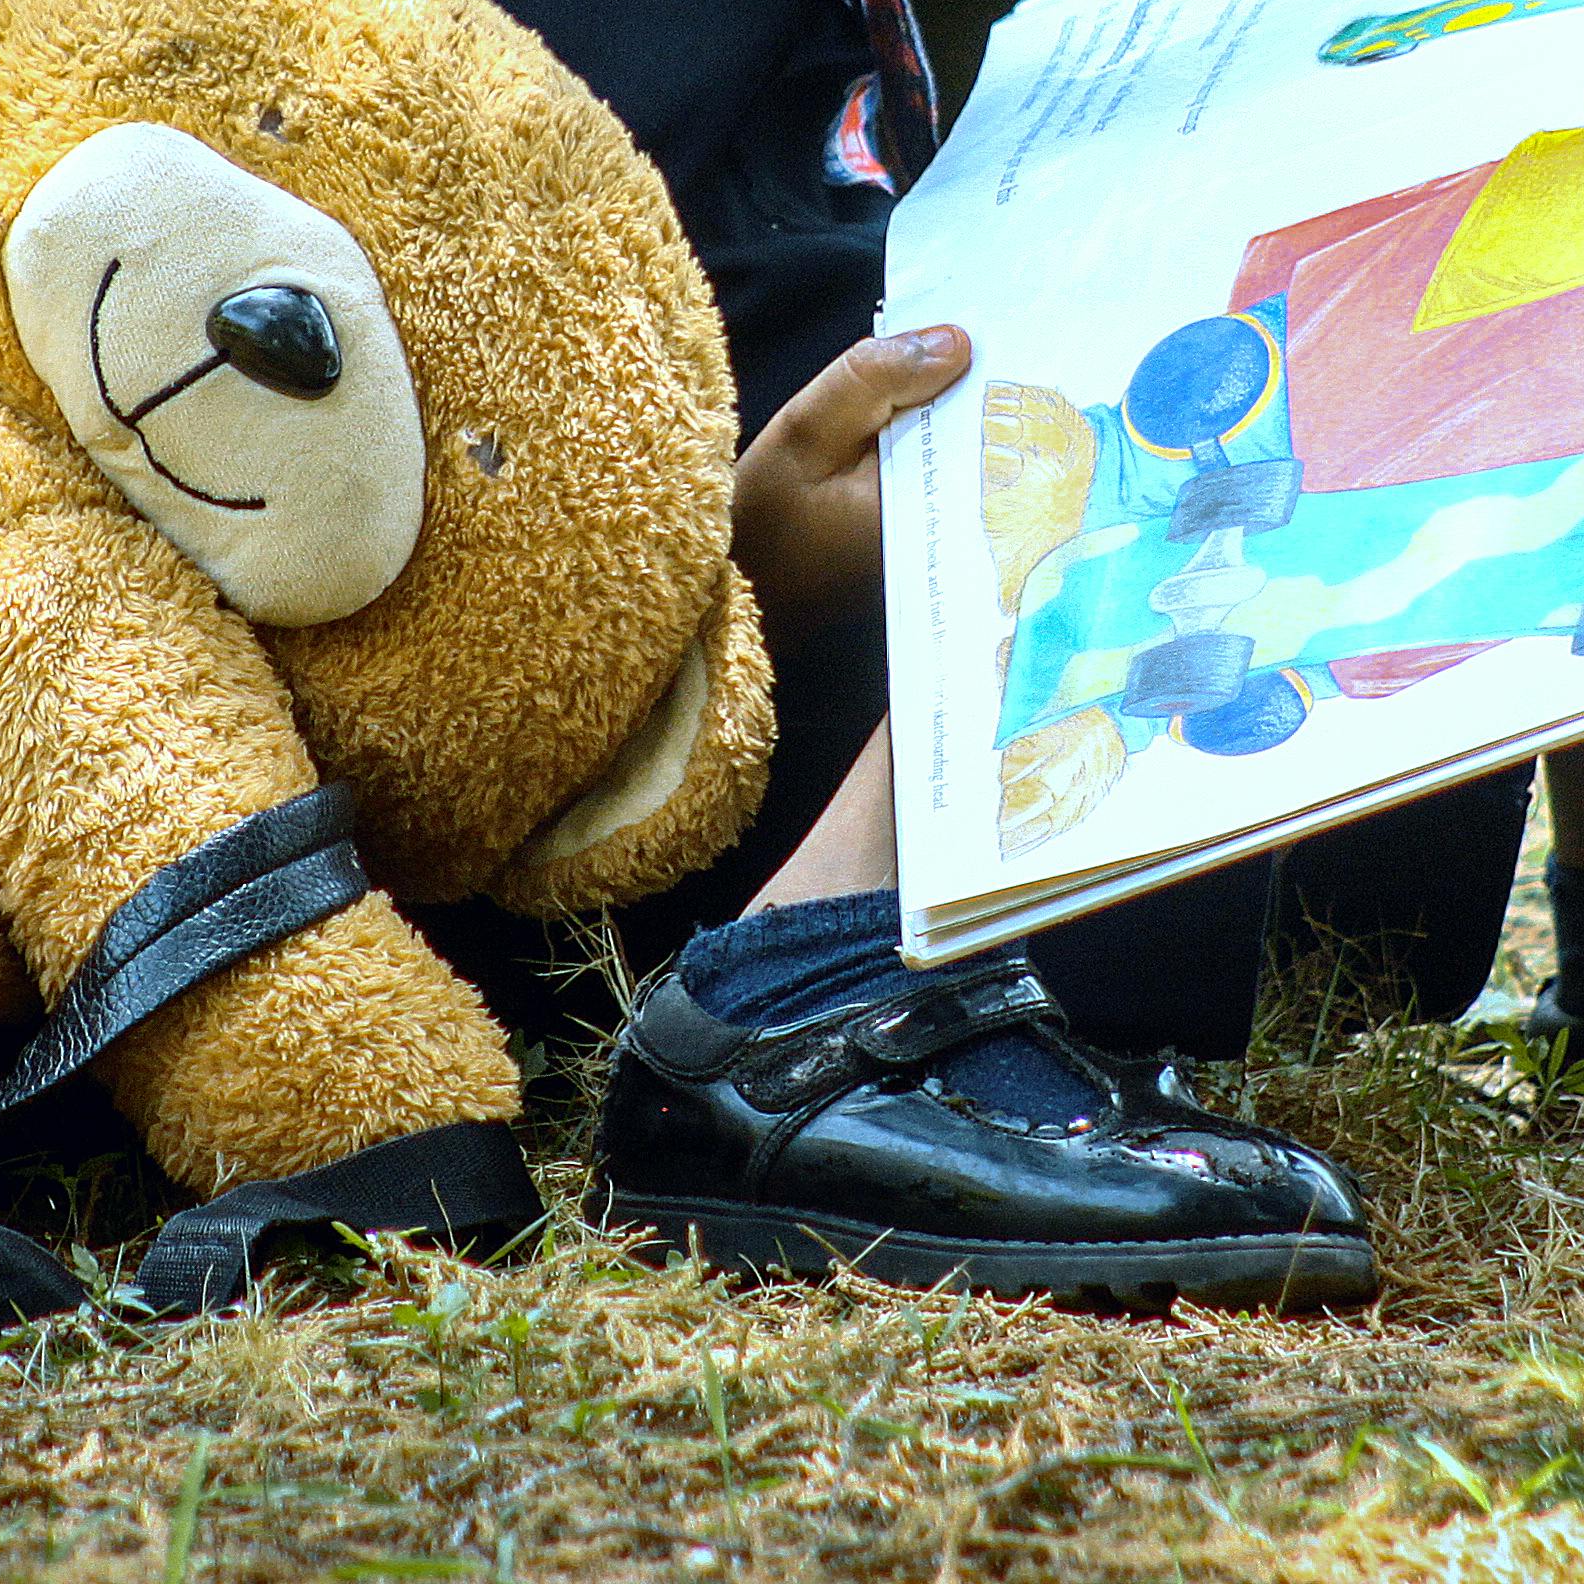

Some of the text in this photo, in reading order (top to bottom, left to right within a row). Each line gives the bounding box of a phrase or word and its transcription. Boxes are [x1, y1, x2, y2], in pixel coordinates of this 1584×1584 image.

[920, 400, 935, 430] Turn
[921, 432, 932, 447] to
[922, 448, 937, 467] the
[923, 469, 938, 496] back
[925, 502, 941, 514] of
[926, 517, 941, 536] the
[927, 539, 942, 571] book
[928, 575, 944, 598] and
[930, 601, 946, 627] find
[928, 710, 950, 782] skateboarding
[932, 783, 949, 813] head.
